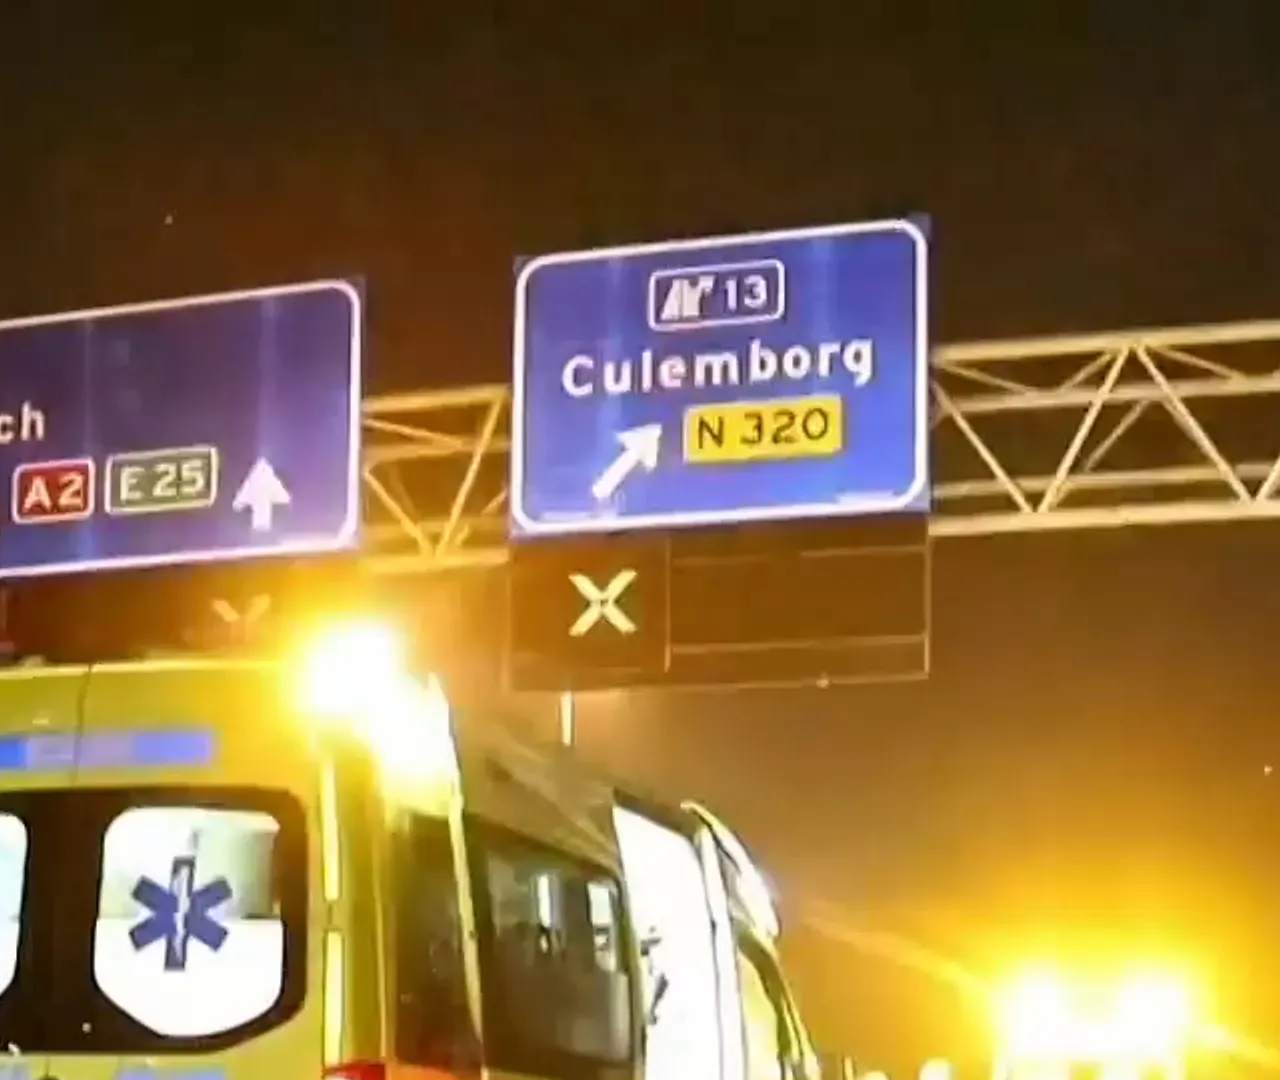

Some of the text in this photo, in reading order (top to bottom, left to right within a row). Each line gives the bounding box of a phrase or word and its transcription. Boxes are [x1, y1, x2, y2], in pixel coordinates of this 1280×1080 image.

[724, 274, 768, 310] 13
[562, 338, 874, 397] Culemborg
[22, 472, 84, 511] A2
